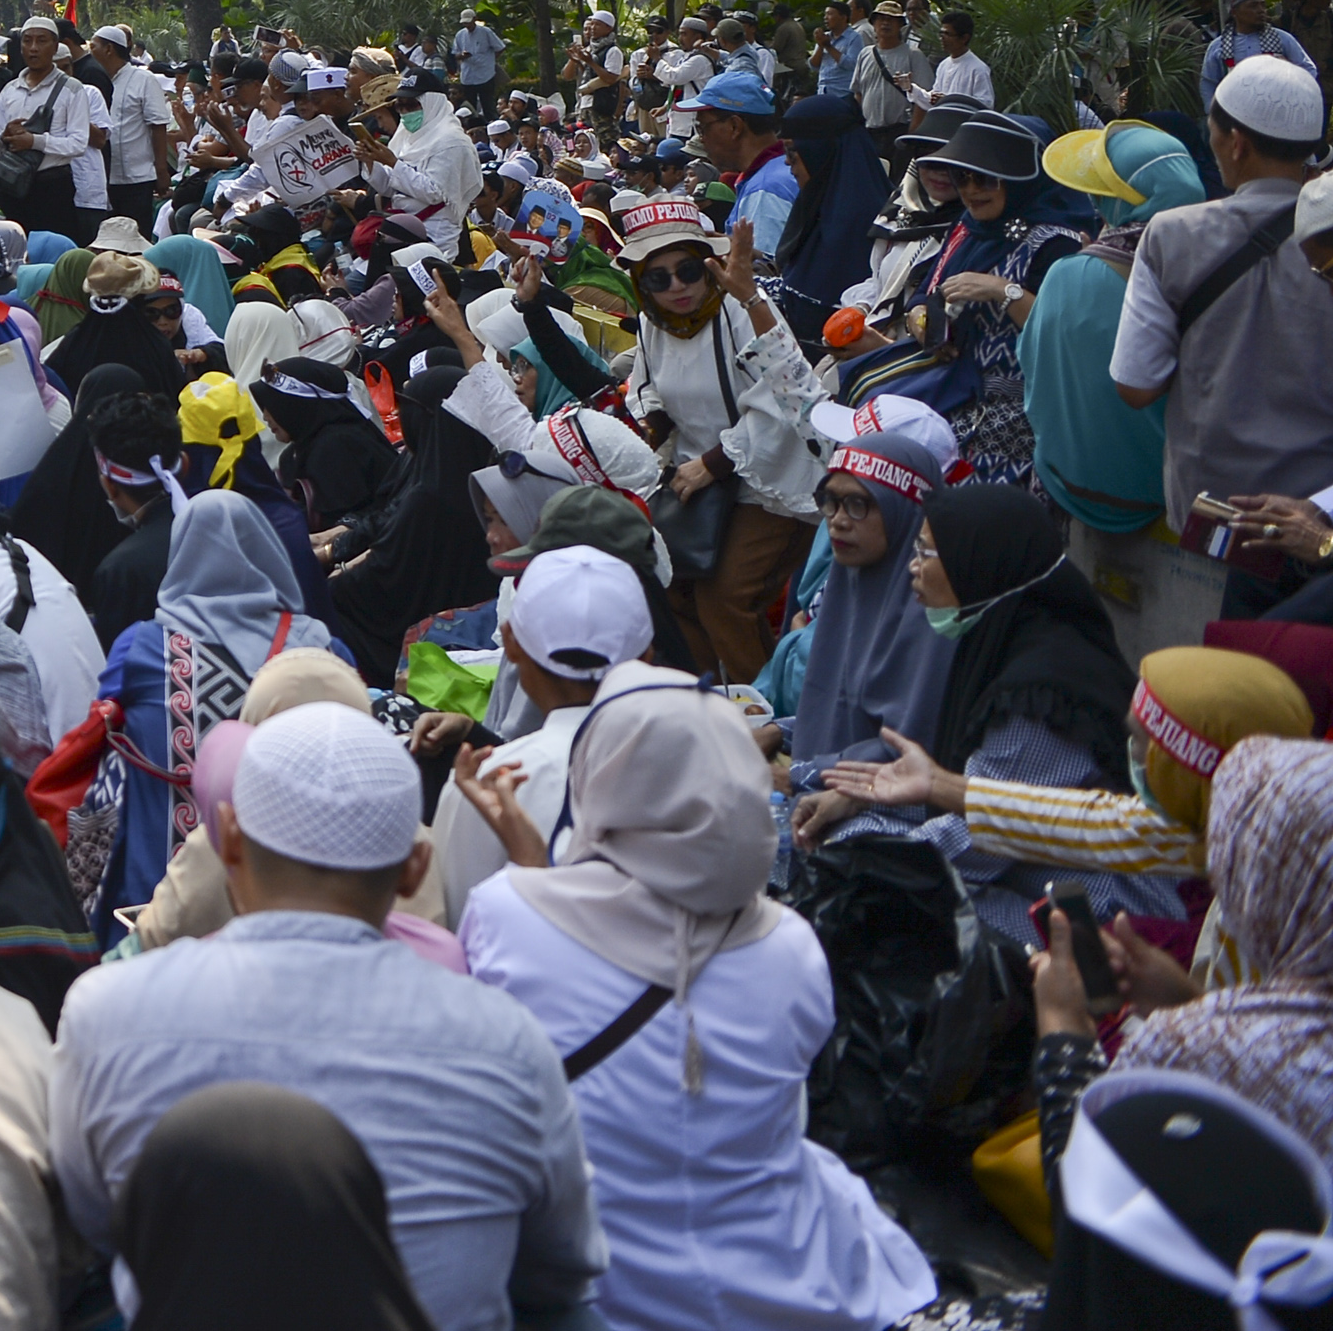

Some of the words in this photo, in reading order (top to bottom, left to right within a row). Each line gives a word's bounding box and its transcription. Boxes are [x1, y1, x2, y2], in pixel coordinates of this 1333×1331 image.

[312, 145, 351, 170] CURANG
[846, 451, 912, 491] PEJUANG
[1140, 695, 1220, 774] PEJUANG
